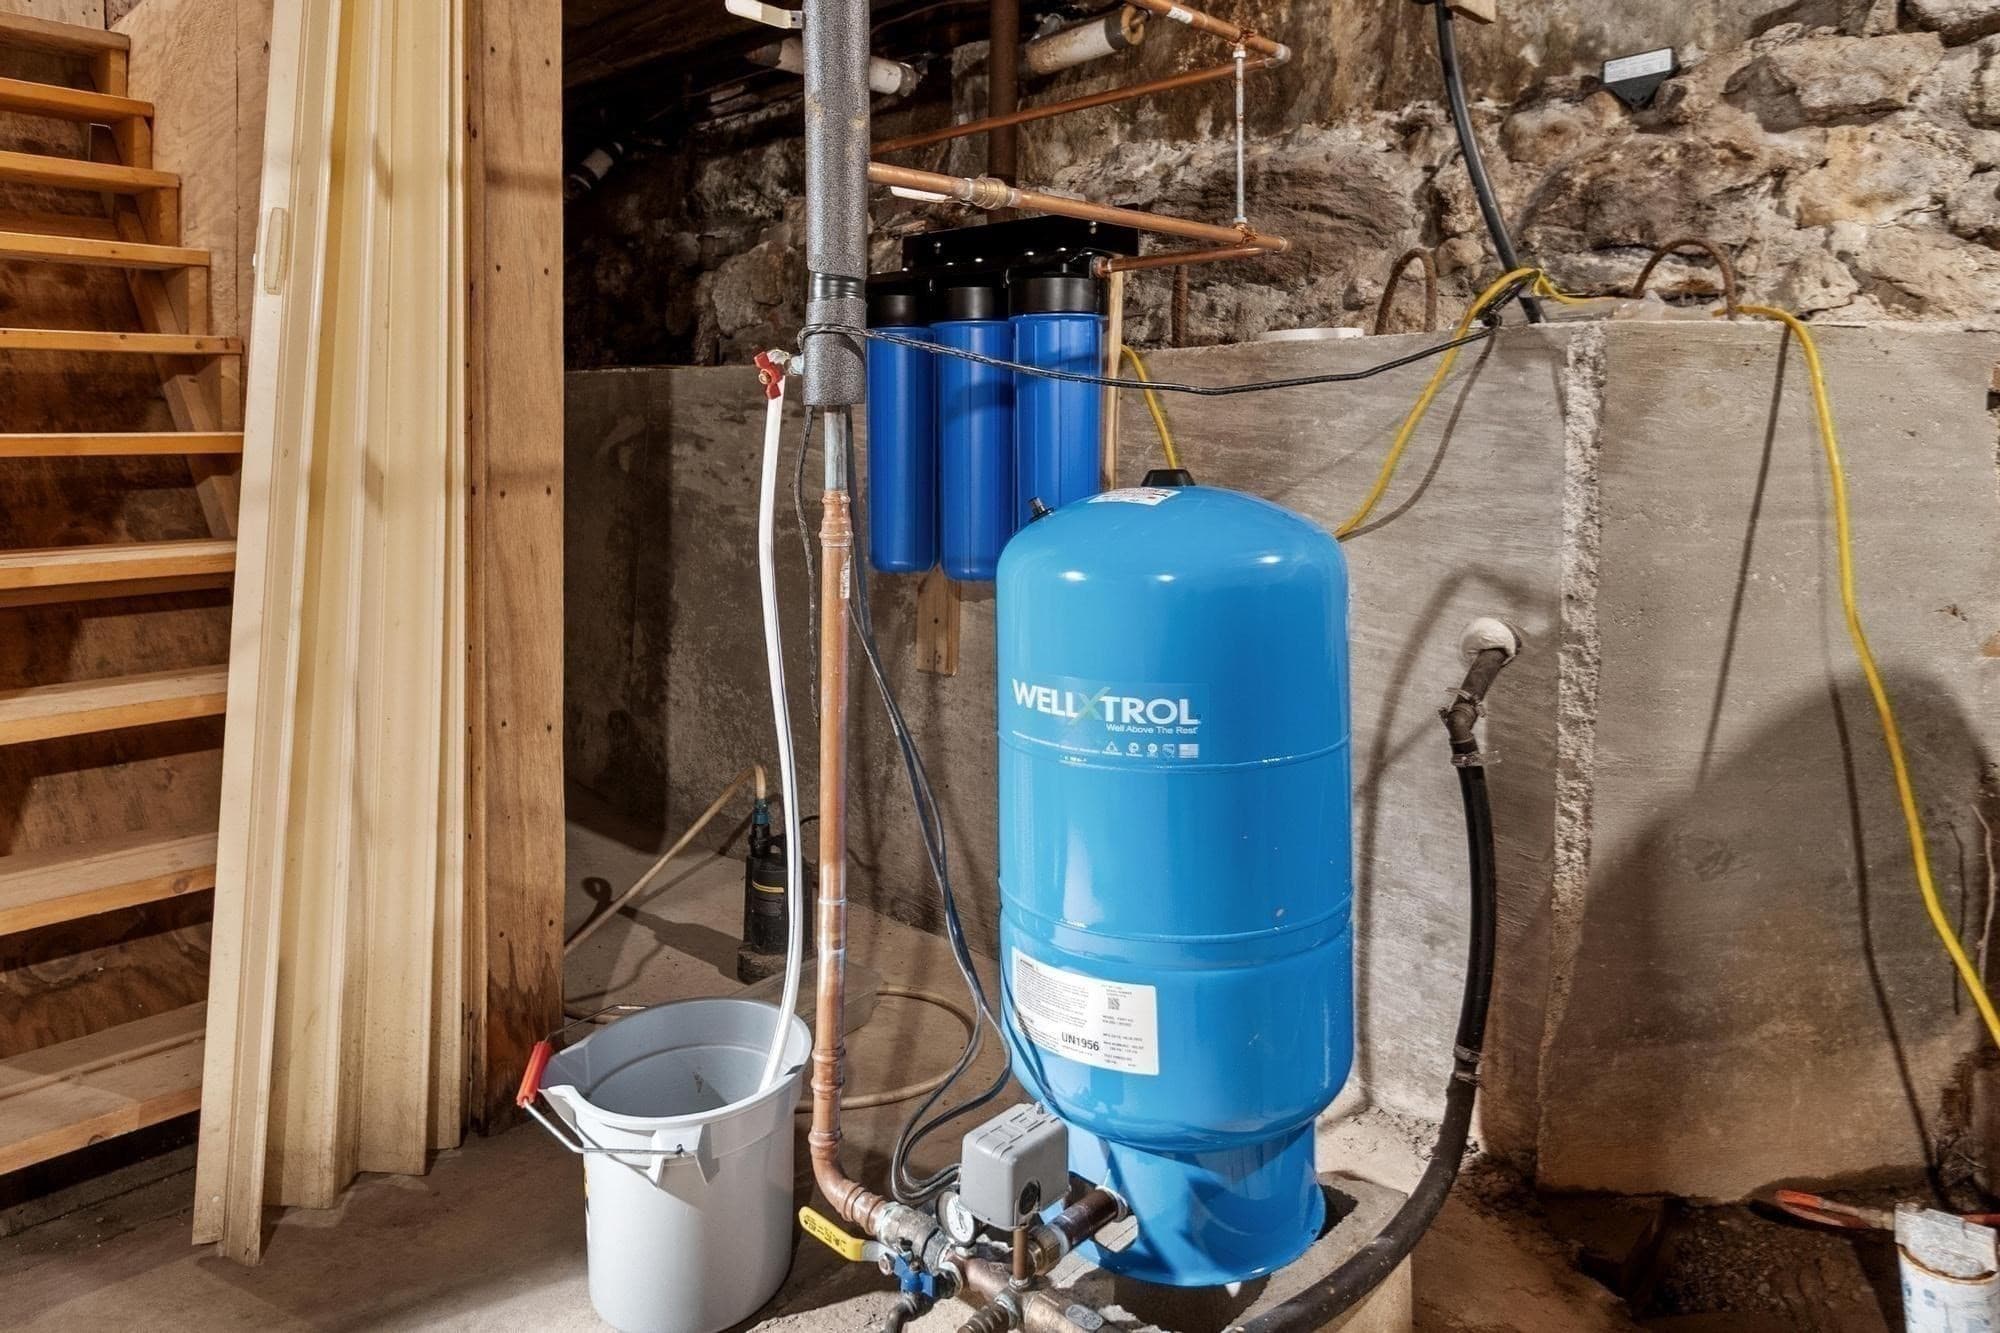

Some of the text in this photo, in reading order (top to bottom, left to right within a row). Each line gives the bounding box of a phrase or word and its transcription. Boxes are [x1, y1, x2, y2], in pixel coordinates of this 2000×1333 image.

[1106, 724, 1197, 735] Well Above The Rest
[1061, 1032, 1100, 1051] UN1956
